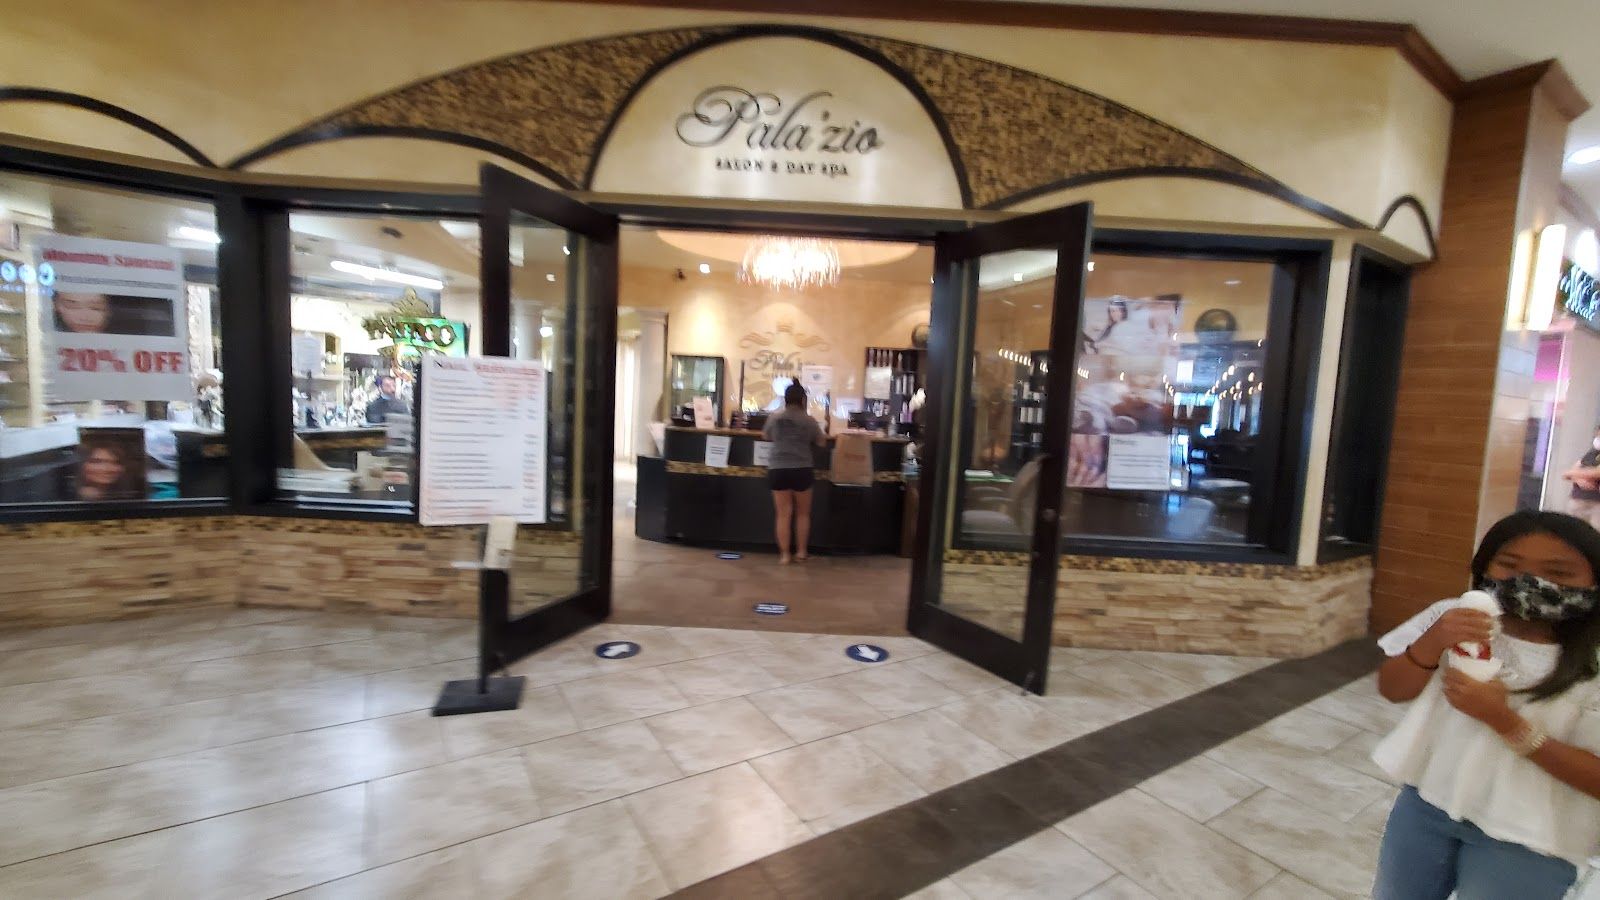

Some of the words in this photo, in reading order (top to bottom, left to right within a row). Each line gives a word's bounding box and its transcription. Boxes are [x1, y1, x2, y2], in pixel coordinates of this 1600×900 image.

[676, 85, 882, 153] Pala'zio
[715, 157, 763, 171] SALON
[821, 161, 849, 178] SPA
[57, 347, 127, 373] 20%
[133, 350, 184, 374] OFF
